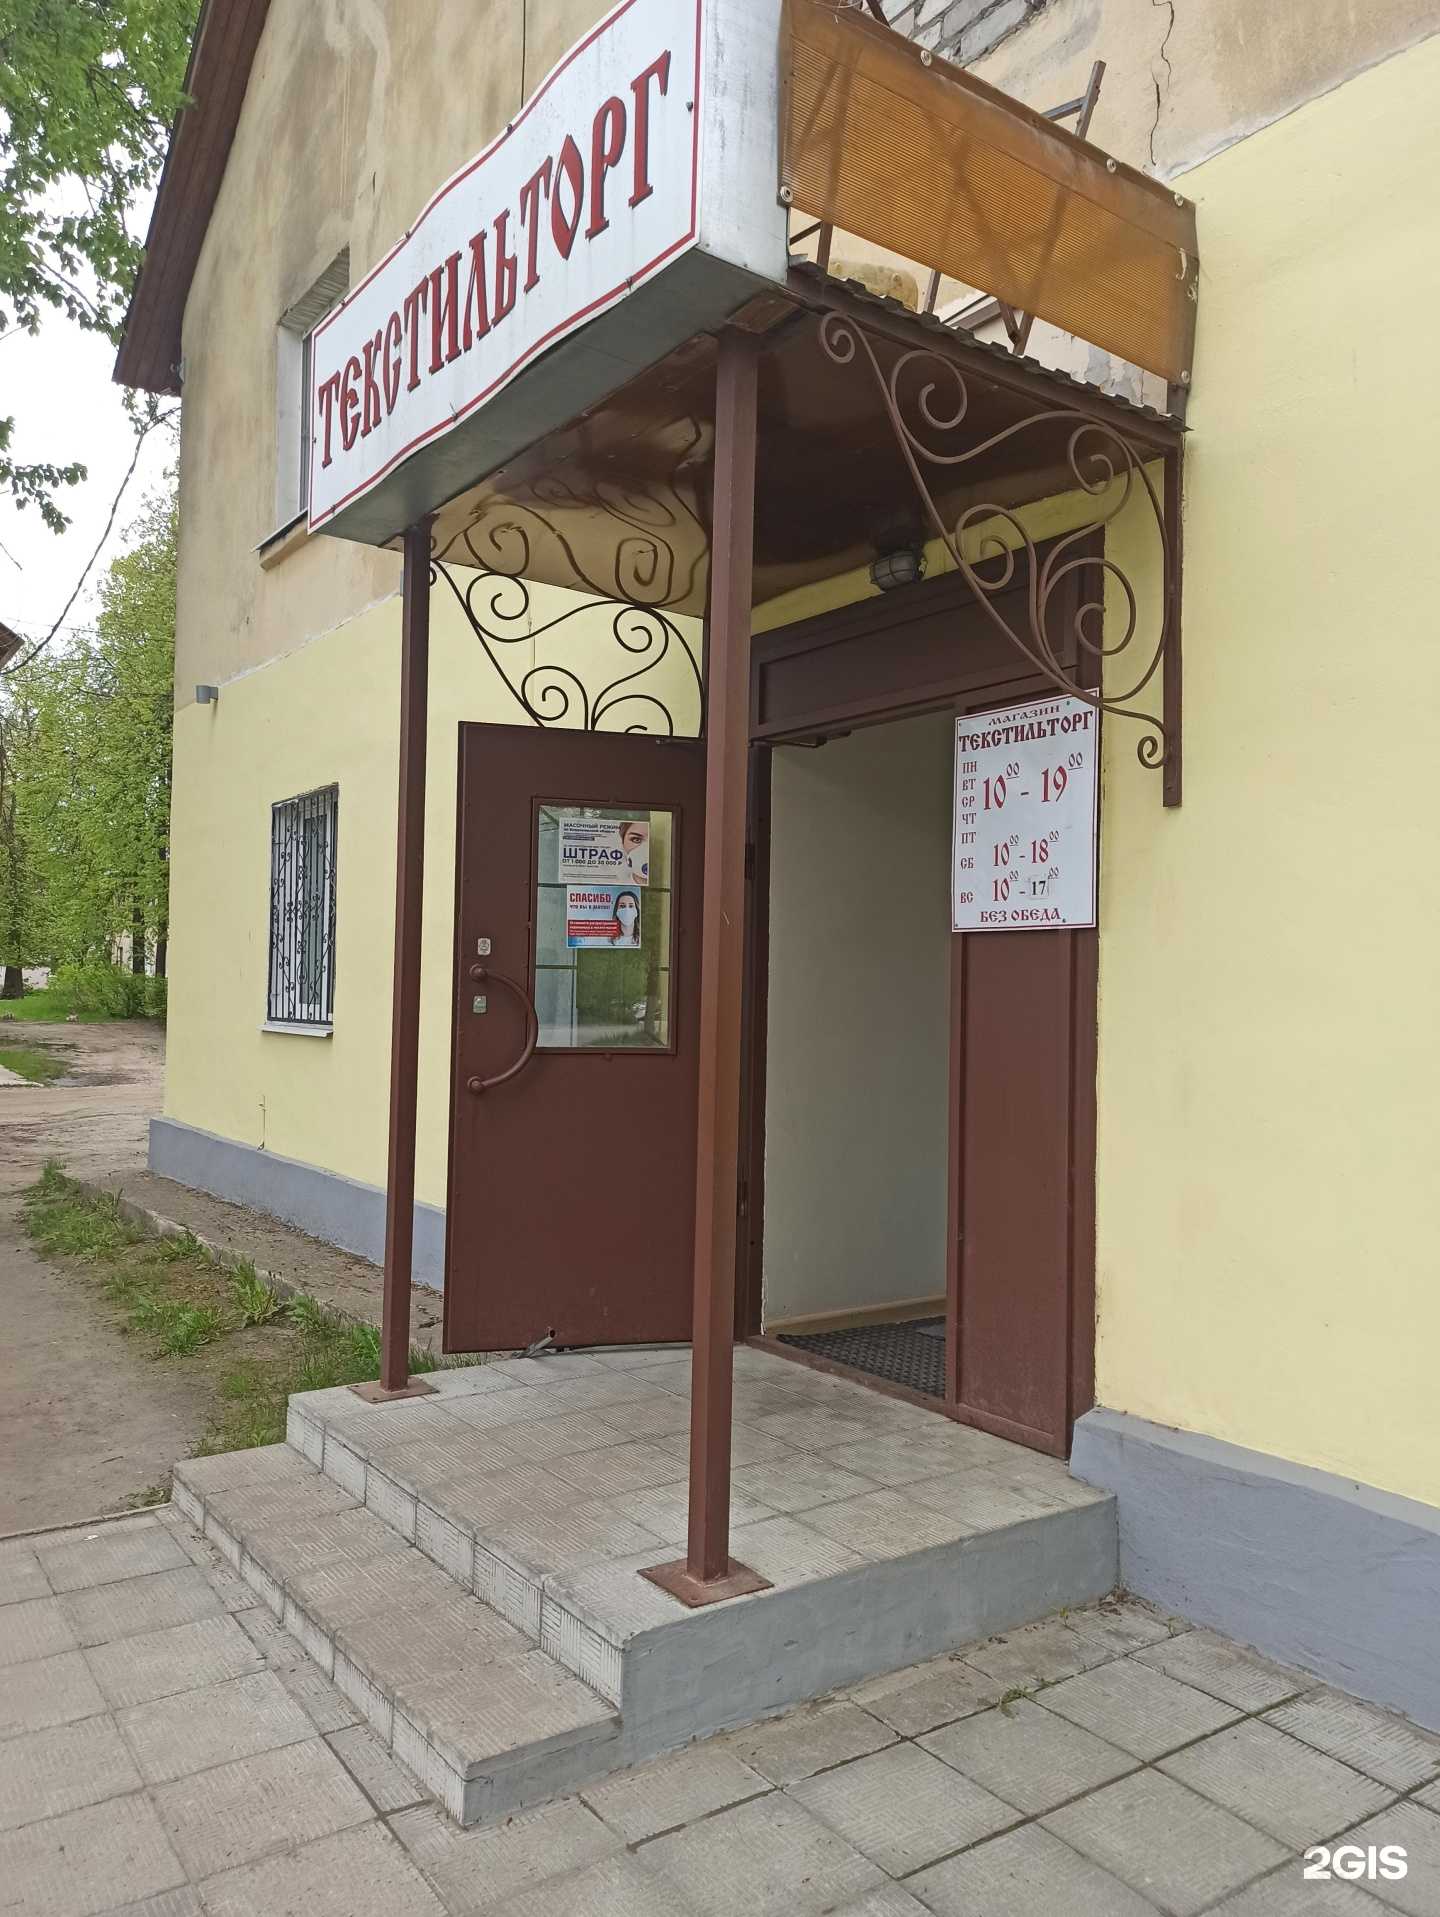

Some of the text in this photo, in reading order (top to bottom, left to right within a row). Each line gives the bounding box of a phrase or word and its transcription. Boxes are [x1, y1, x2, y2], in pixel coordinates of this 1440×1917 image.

[318, 49, 671, 470] ТЕКСТИЛЬТОРГ
[959, 710, 1094, 752] ТЕКСТИЛЬТОРГ
[962, 761, 977, 774] ПН
[962, 779, 976, 791] ВТ
[961, 795, 975, 808] СР
[961, 812, 976, 825] ЧТ
[961, 831, 976, 844] ПТ
[563, 847, 623, 861] ШТРАФ
[960, 857, 974, 870] СБ
[960, 891, 974, 904] ВС
[980, 907, 1061, 923] БЕЗ ОБЕДА
